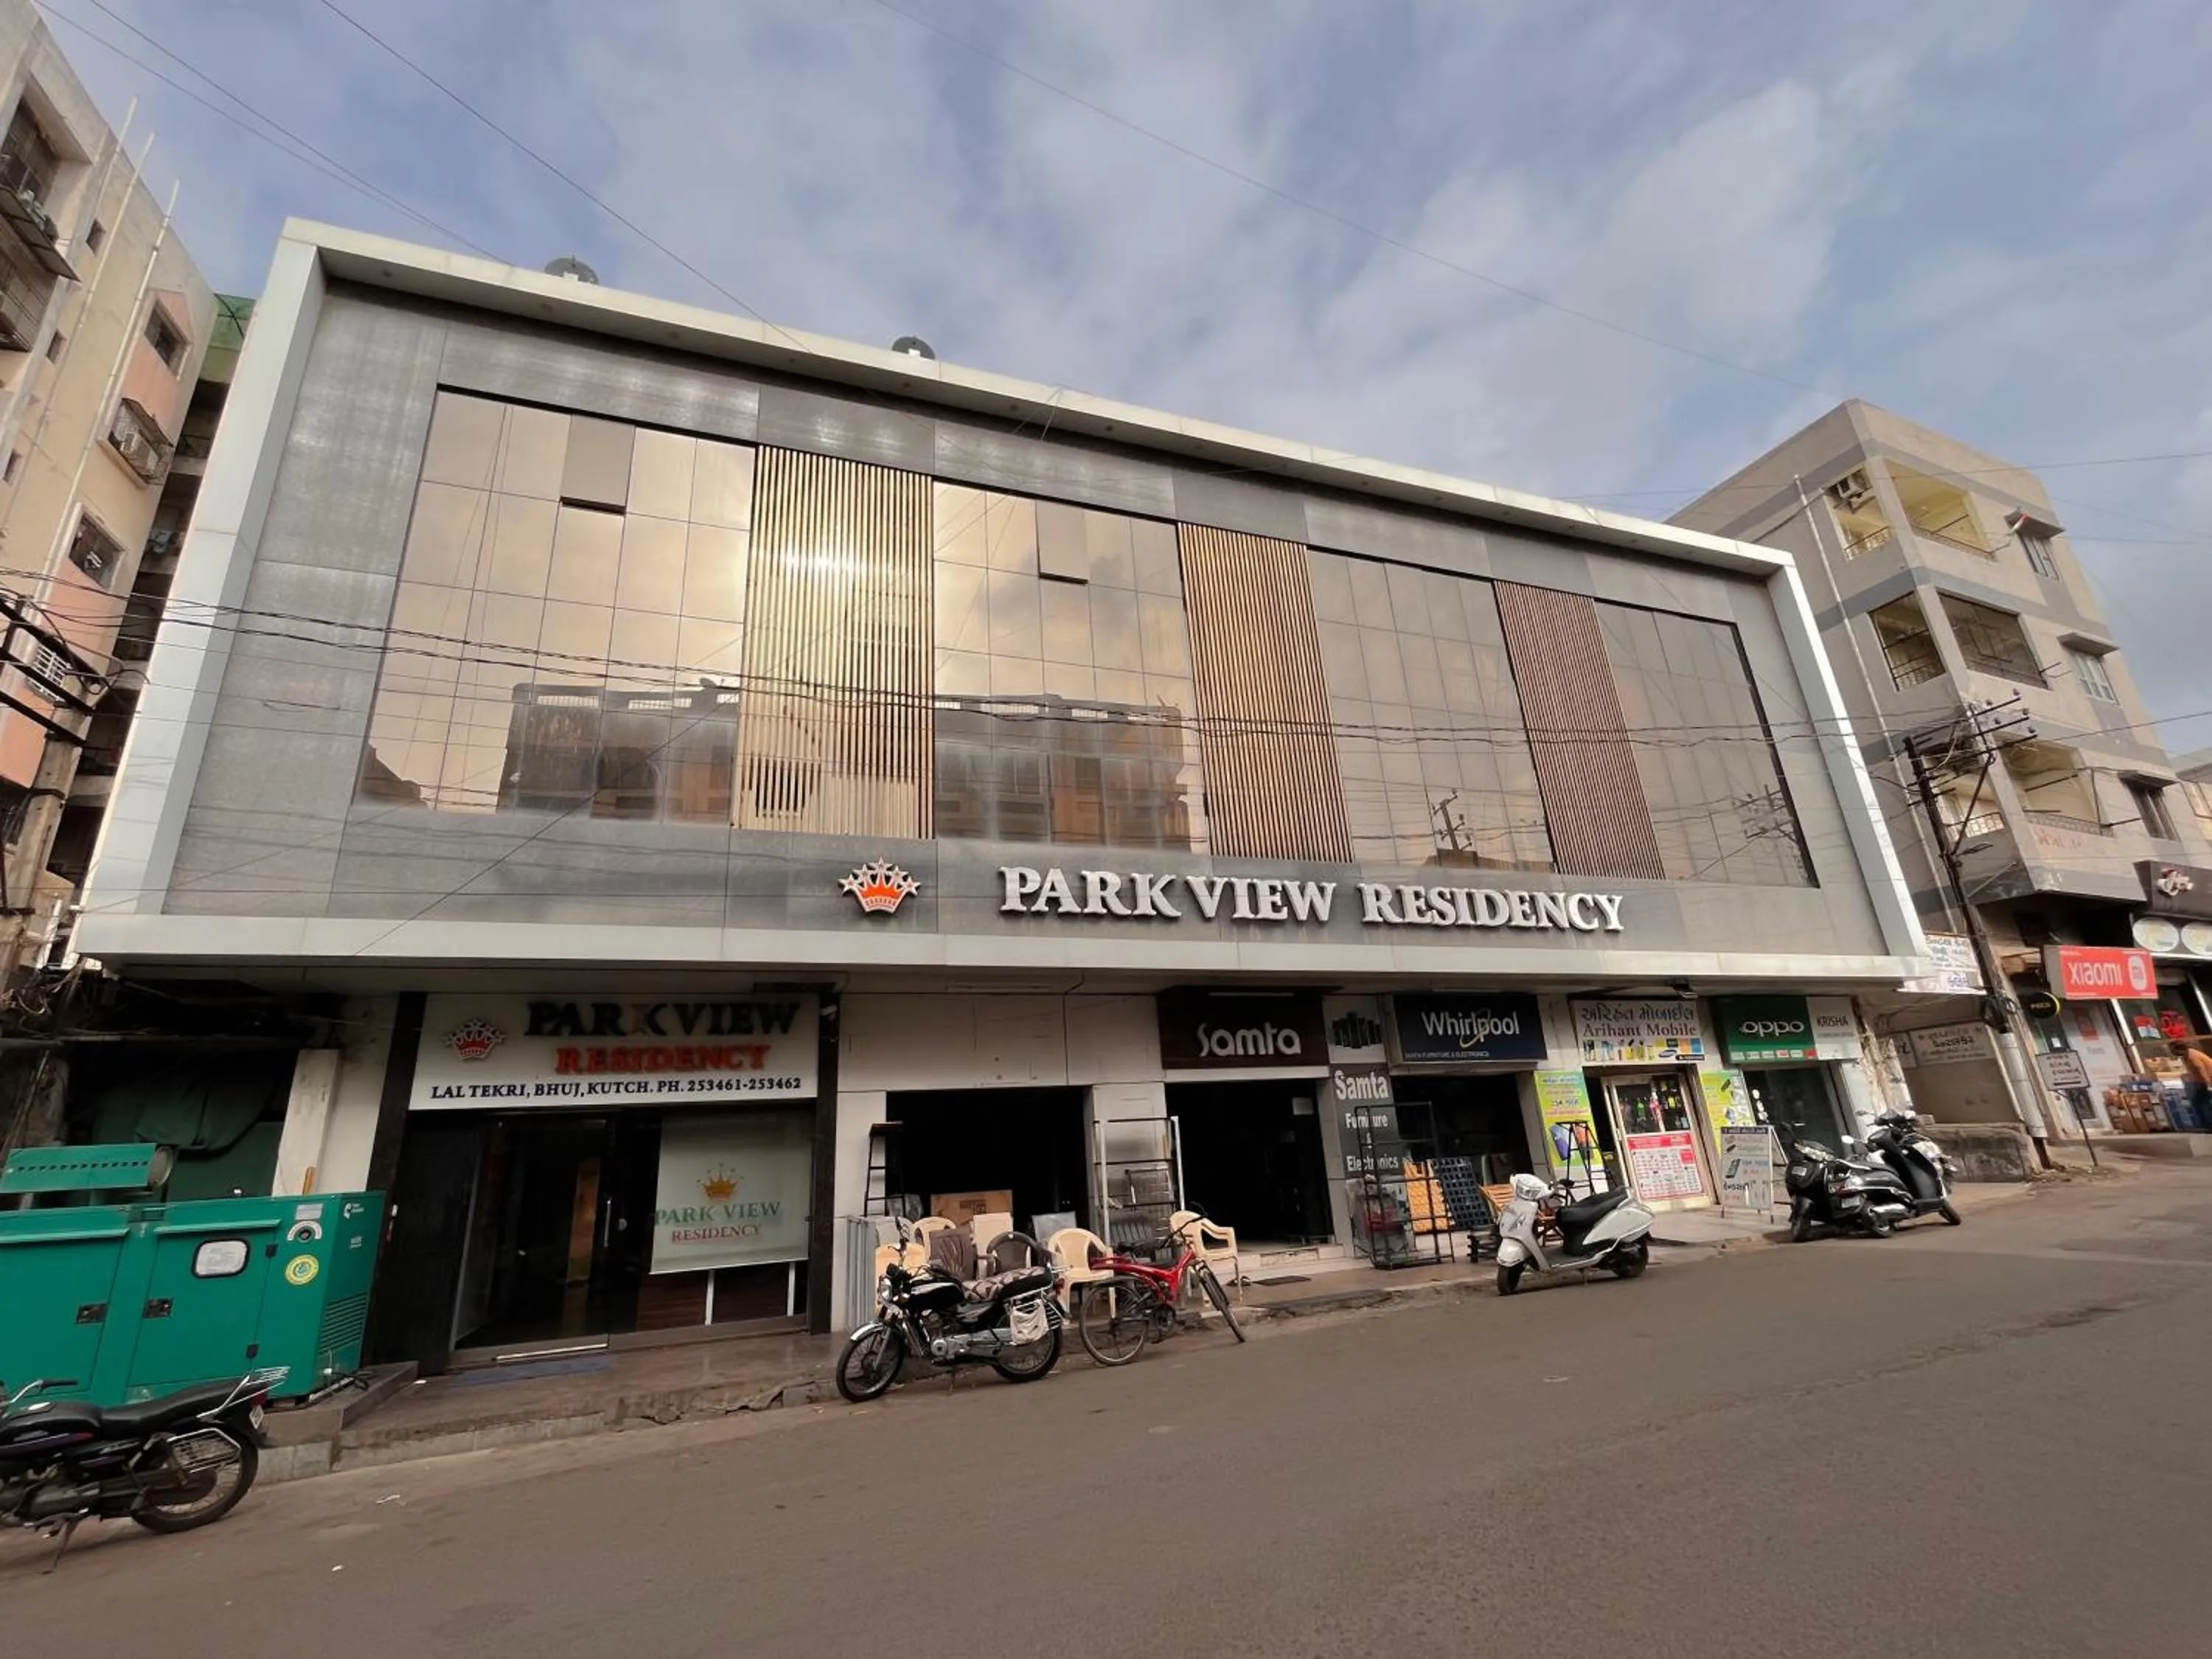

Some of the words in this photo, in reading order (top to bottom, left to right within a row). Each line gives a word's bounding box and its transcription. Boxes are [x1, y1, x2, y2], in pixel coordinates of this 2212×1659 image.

[1357, 883, 1624, 931] RESIDENCY
[1197, 1021, 1301, 1057] Samta
[1421, 1011, 1520, 1043] Whirlpool
[1583, 1023, 1641, 1037] Arihant
[1646, 1022, 1697, 1037] Mobile
[554, 1043, 772, 1075] RESIDENCY
[431, 1085, 465, 1099] LAL
[656, 1079, 684, 1093] PH.
[686, 1077, 801, 1092] 253461-253462
[1334, 1069, 1389, 1100] Samta
[1345, 1111, 1388, 1129] Furniure
[1346, 1153, 1399, 1171] Electrnics
[655, 1205, 716, 1225] PARK
[723, 1201, 781, 1219] VIEW
[672, 1224, 762, 1243] RESIDENCY
